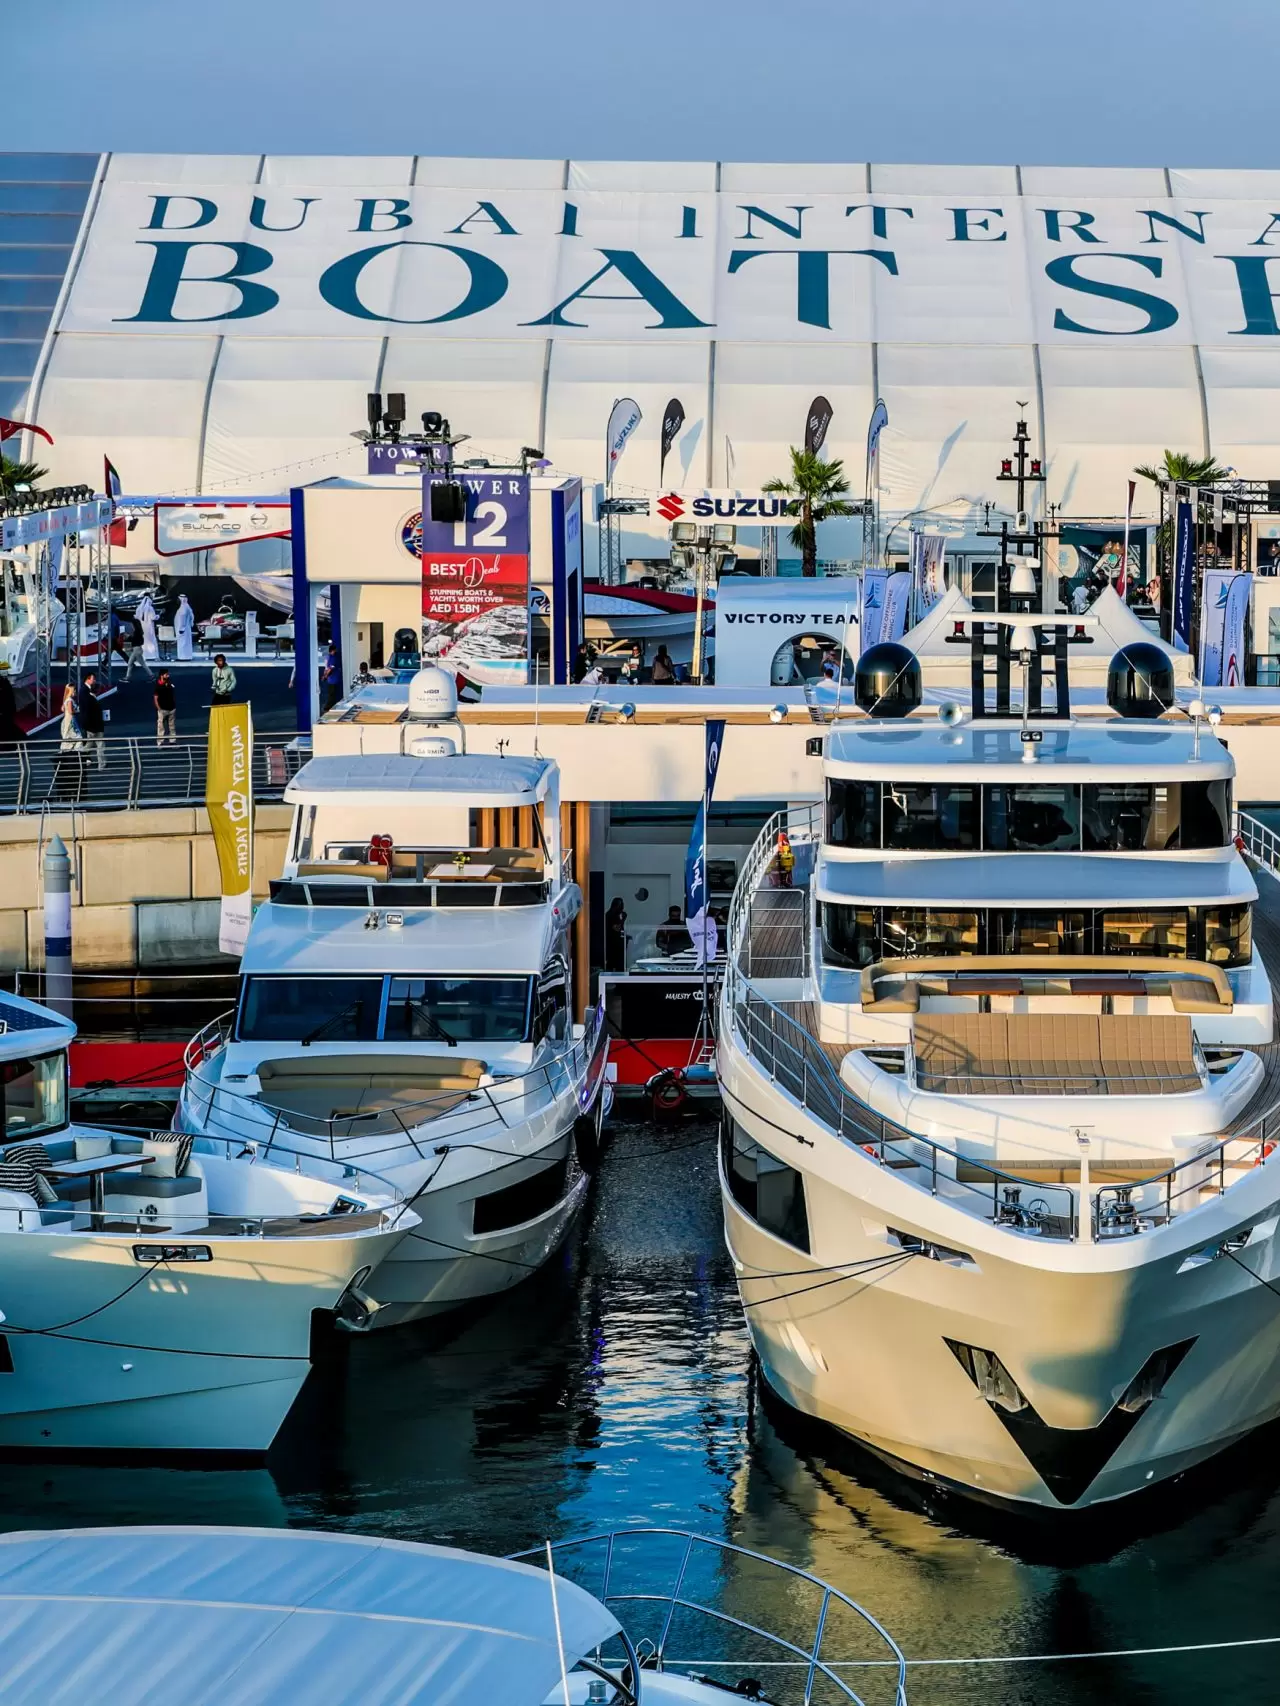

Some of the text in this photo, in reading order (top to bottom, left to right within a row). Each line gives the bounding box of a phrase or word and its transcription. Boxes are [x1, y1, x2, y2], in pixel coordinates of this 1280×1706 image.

[138, 194, 583, 237] DUBAI
[111, 239, 900, 331] BOAT
[614, 413, 638, 450] SUZUKI
[430, 479, 521, 495] WER
[692, 497, 804, 517] SUZUK
[430, 563, 466, 576] BEST
[429, 588, 463, 596] STUNNING
[429, 595, 457, 603] YACHTS
[430, 603, 452, 613] AED
[724, 613, 806, 625] VICTORY
[665, 992, 692, 1000] MAJESTY
